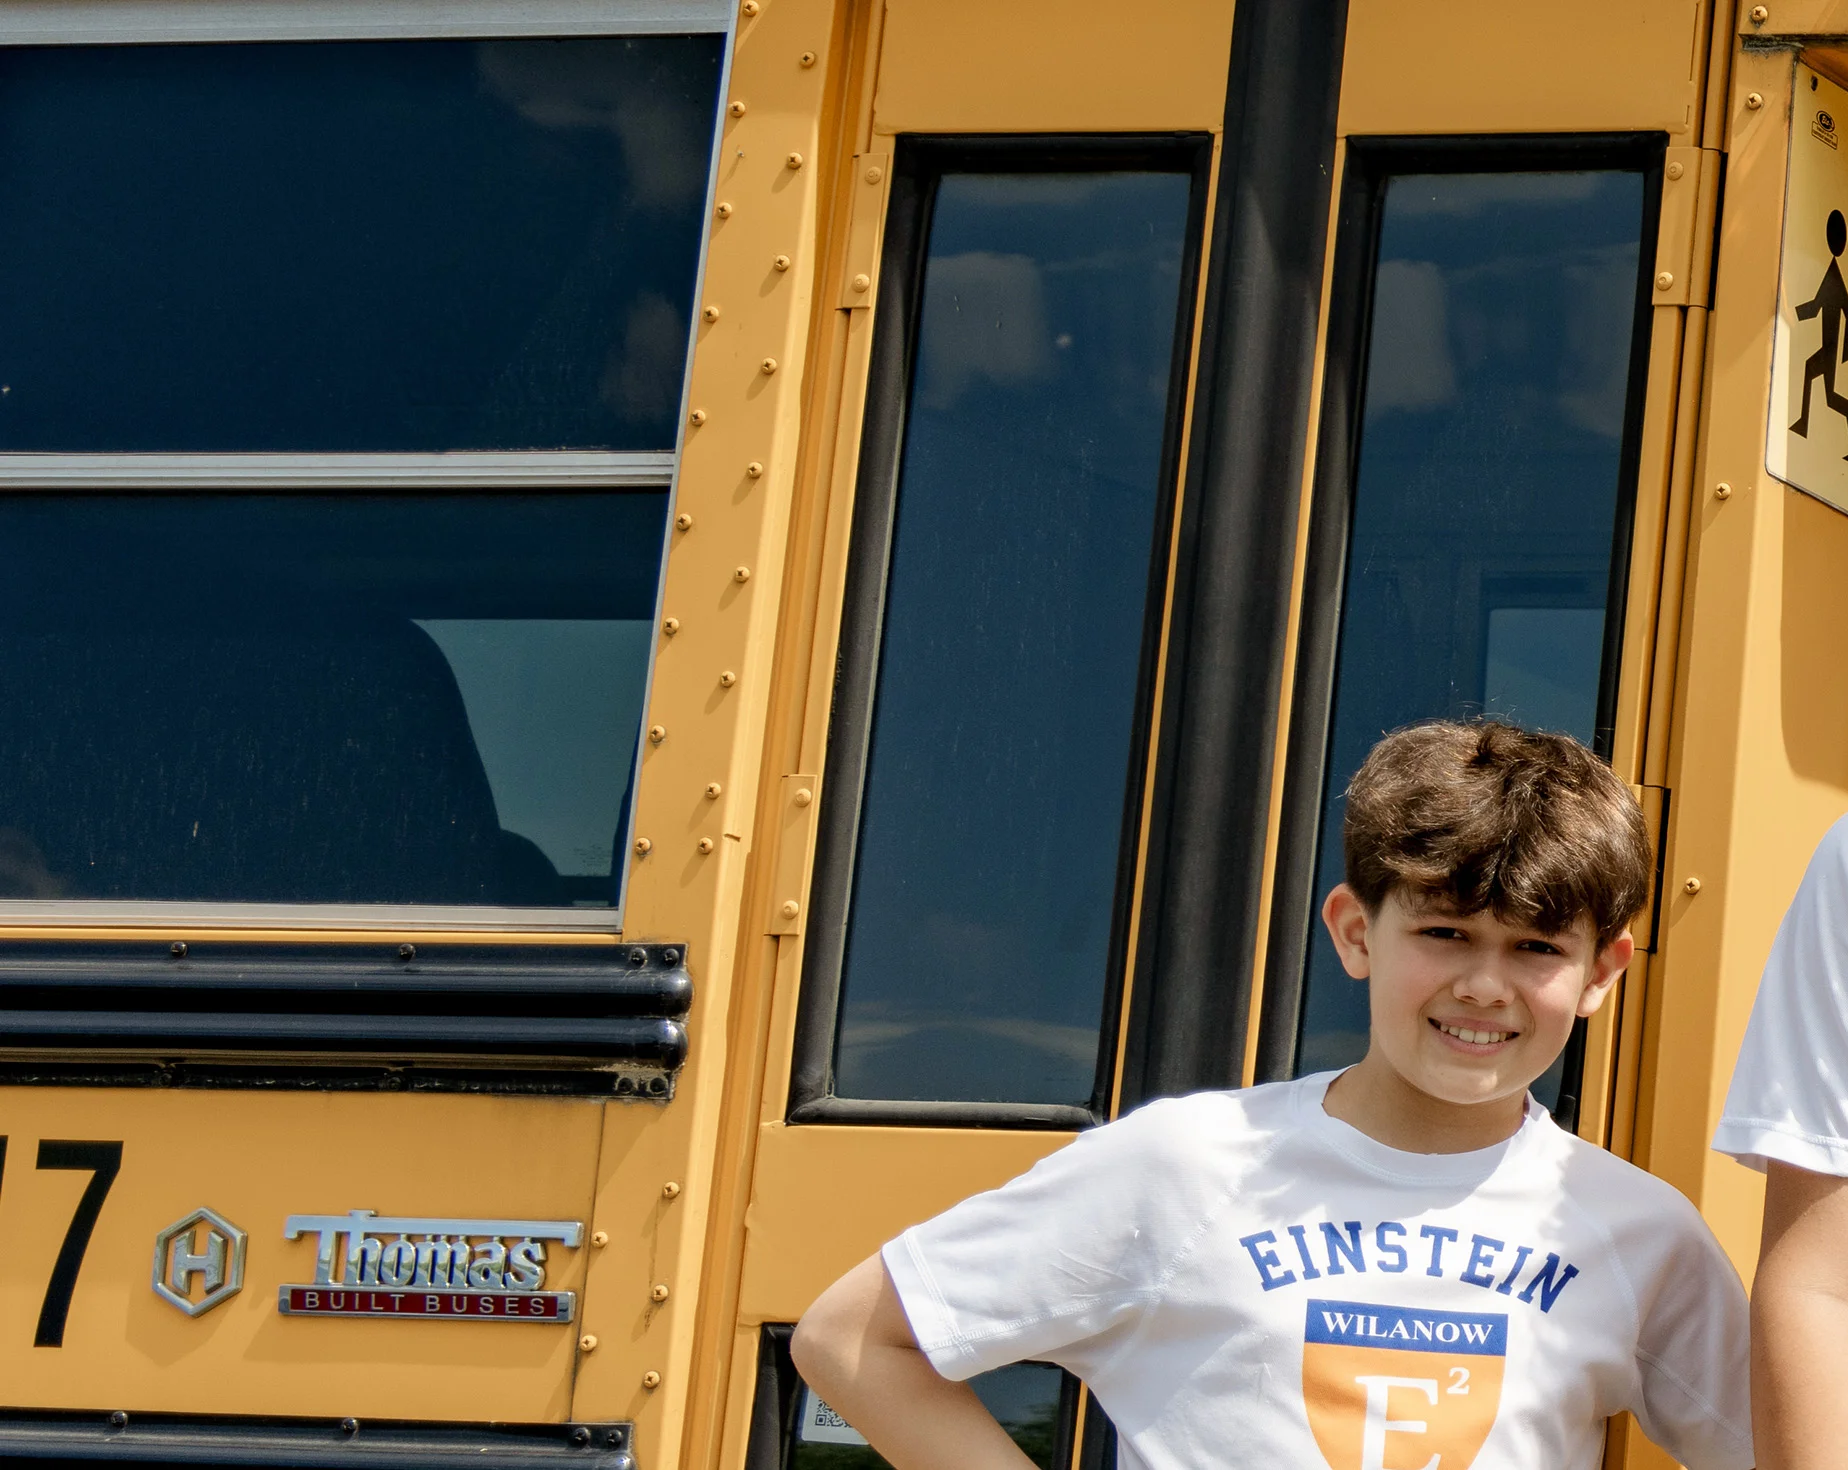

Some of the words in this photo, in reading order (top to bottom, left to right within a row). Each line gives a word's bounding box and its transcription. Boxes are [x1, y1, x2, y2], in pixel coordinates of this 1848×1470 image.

[0, 1135, 124, 1348] 7
[284, 1210, 584, 1291] Thomas
[1239, 1221, 1580, 1314] EINSTEIN
[305, 1291, 405, 1310] BUILT
[425, 1295, 545, 1315] BUSES
[1321, 1312, 1493, 1345] WILANOW
